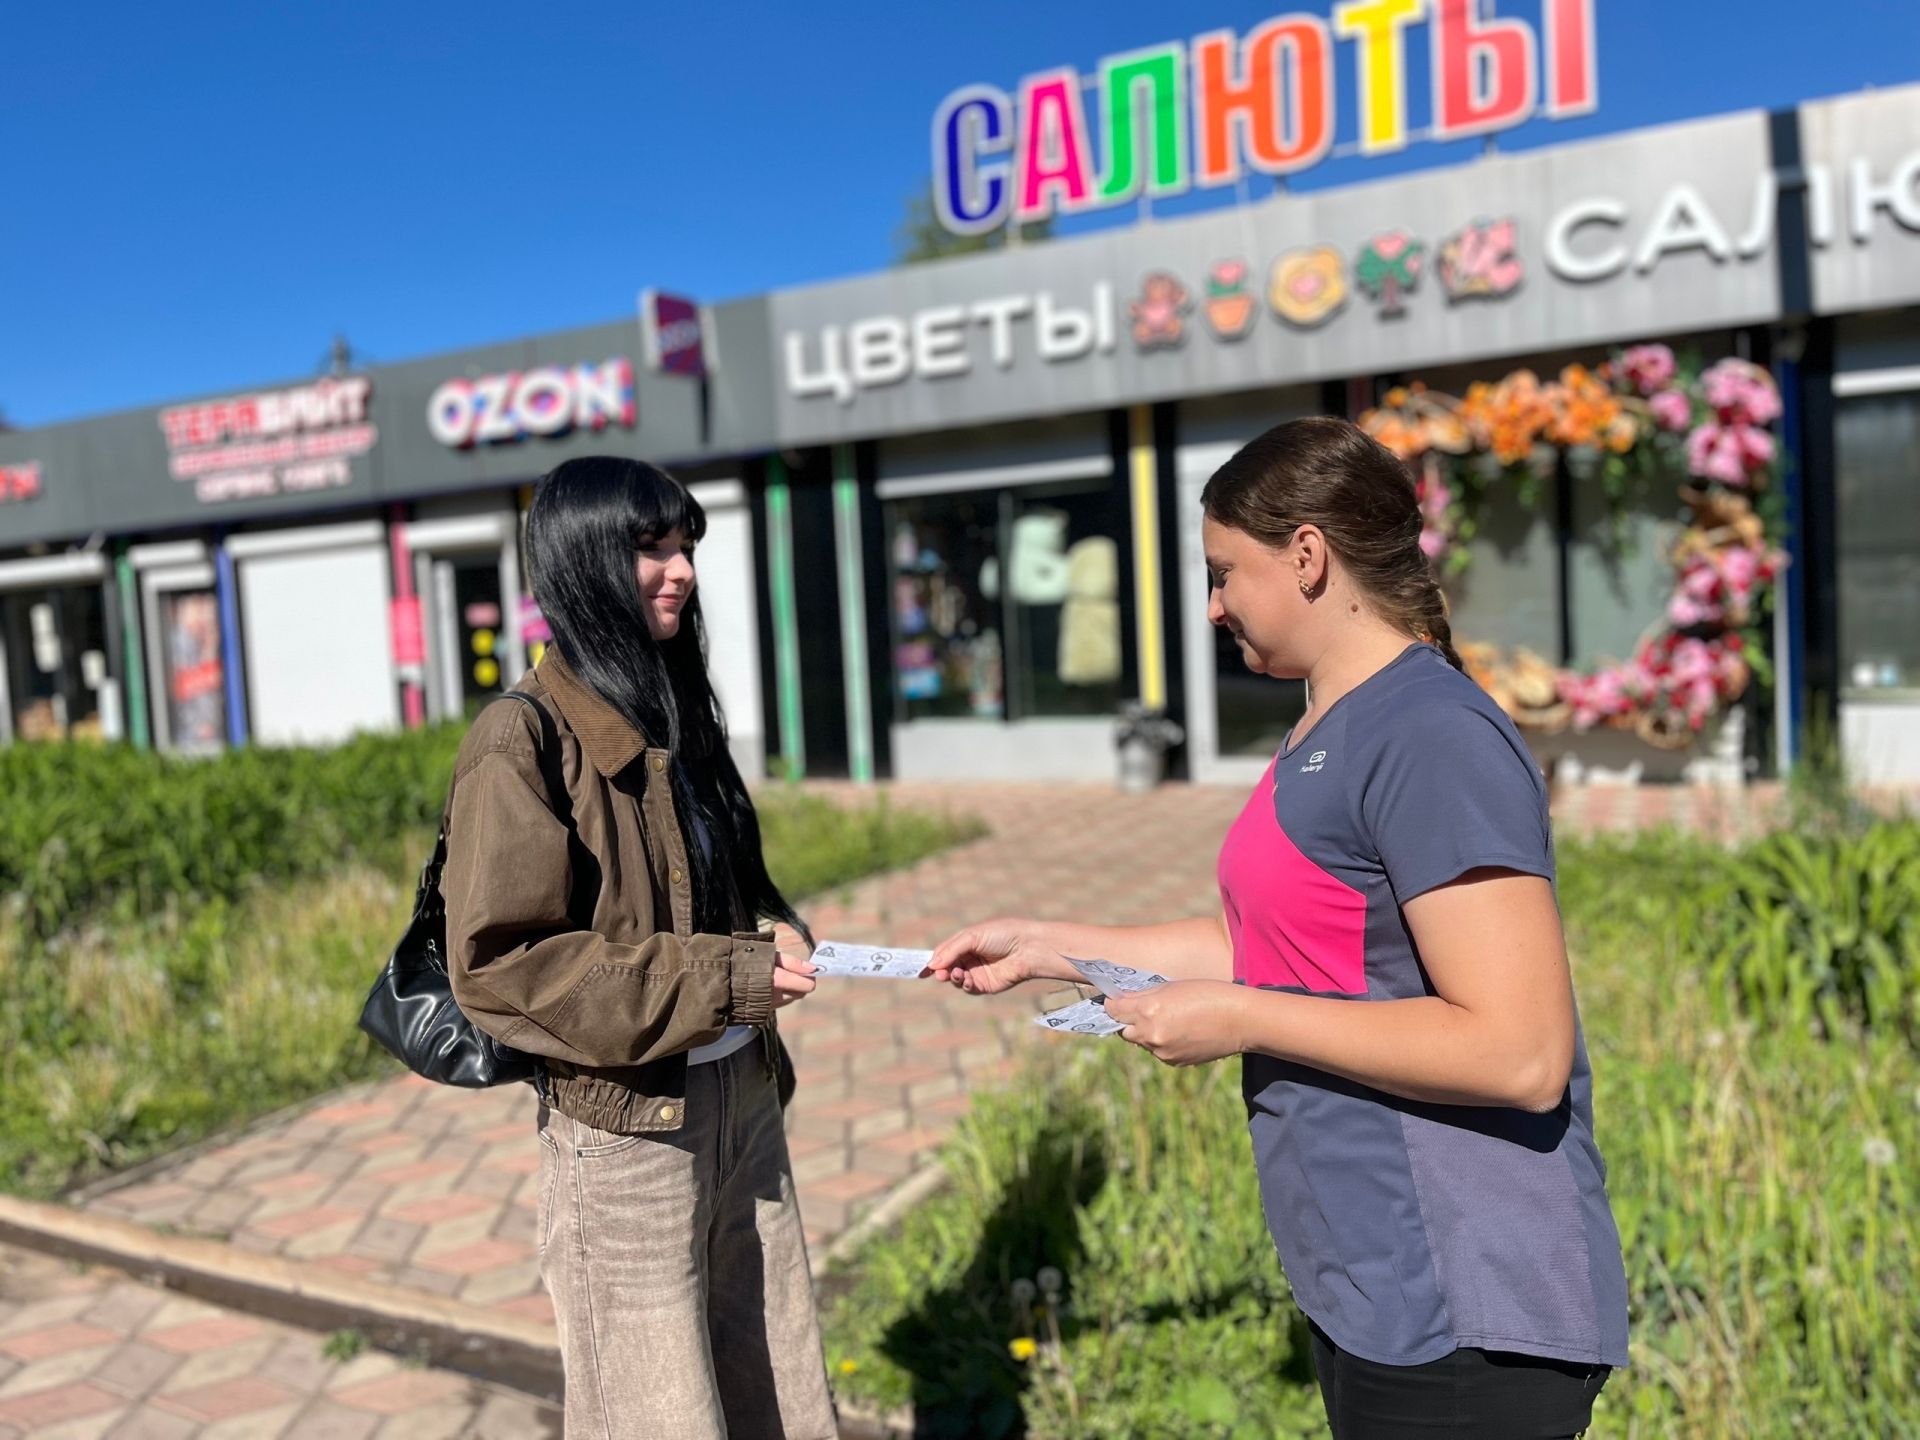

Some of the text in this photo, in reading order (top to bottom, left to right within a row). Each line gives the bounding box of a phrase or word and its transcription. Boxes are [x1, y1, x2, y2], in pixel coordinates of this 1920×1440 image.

[934, 0, 1598, 236] САЛЮТЫ
[427, 357, 634, 447] OZON
[783, 281, 1116, 402] ЦВЕТЫ
